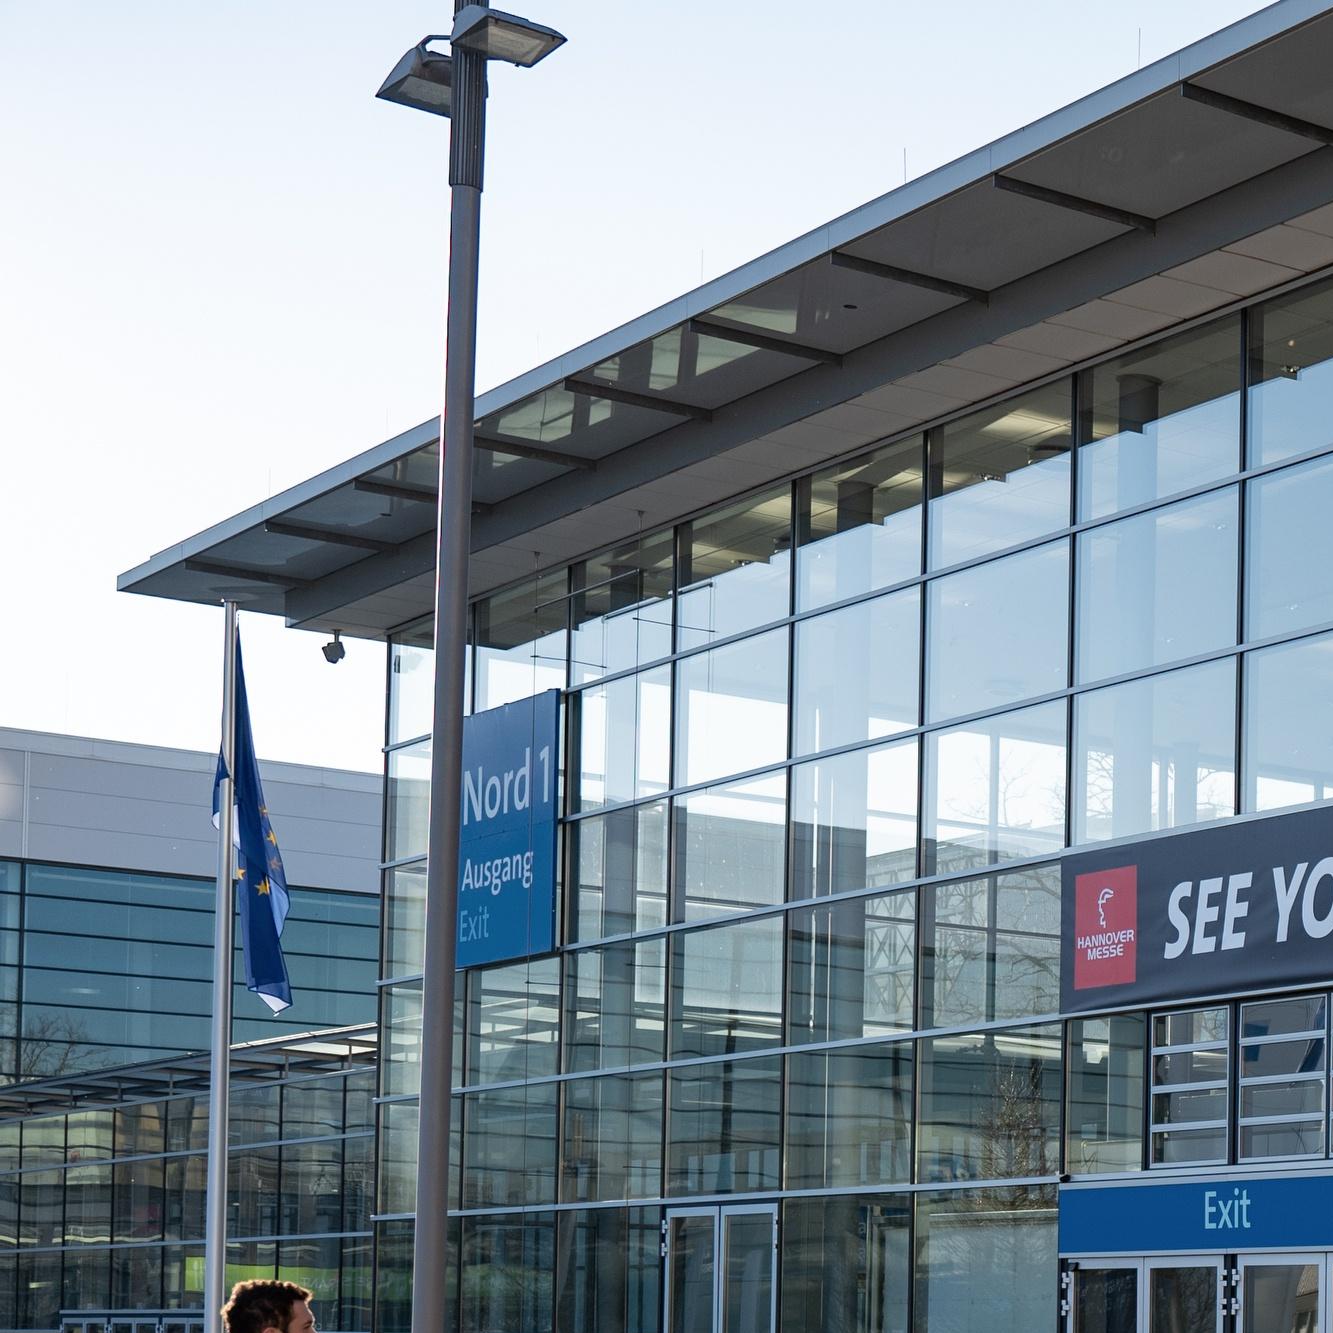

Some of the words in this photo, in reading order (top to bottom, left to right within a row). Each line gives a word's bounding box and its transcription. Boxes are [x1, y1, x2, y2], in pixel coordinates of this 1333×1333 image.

[463, 747, 531, 826] Nord
[539, 745, 550, 803] 1
[461, 851, 534, 896] Ausgang
[459, 905, 490, 943] Exit
[1164, 872, 1253, 959] SEE
[1077, 929, 1134, 949] HANNOVER
[1087, 944, 1124, 961] MESSE
[1204, 1188, 1251, 1230] Exit
